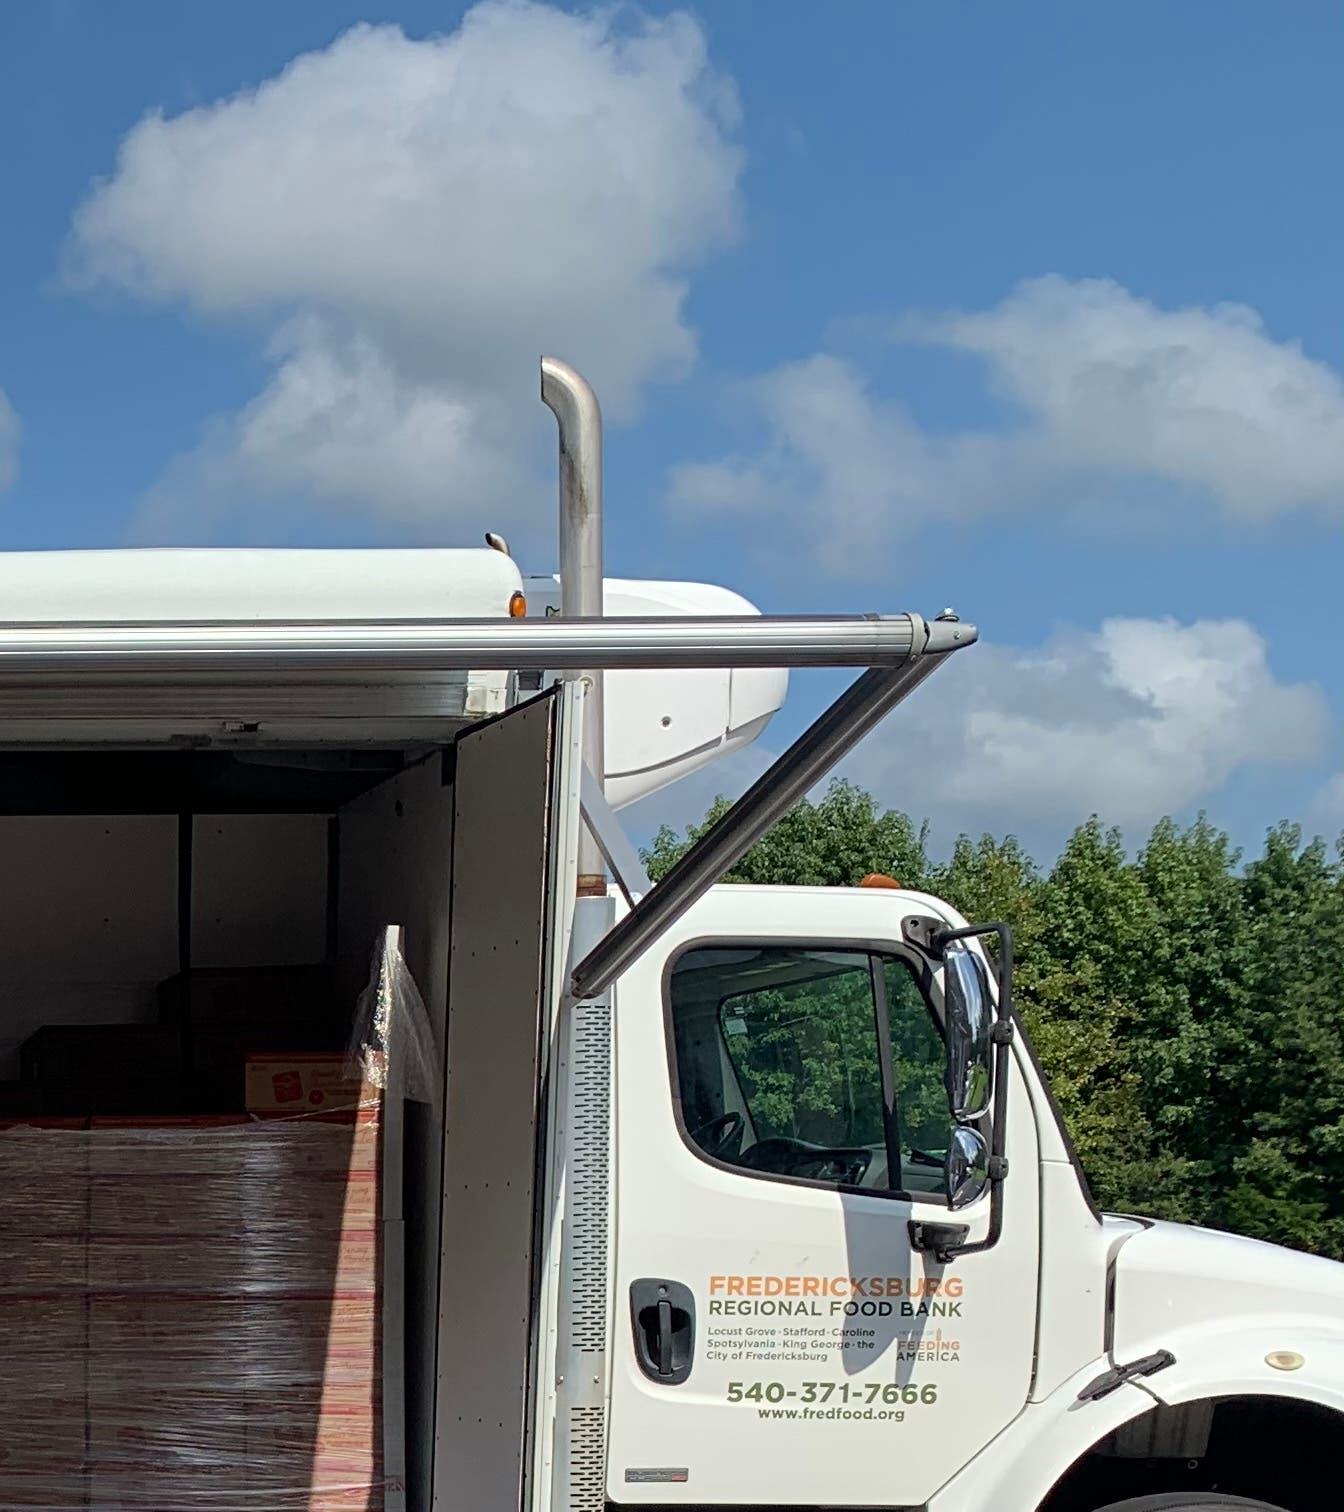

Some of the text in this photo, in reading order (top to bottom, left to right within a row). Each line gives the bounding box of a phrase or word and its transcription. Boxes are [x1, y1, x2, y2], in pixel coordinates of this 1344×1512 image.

[709, 1275, 964, 1298] FREDERICKSBURG
[709, 1300, 963, 1317] REGIONAL FOOD BANK
[708, 1327, 876, 1337] Locust Grove Stafford Caroline
[707, 1339, 875, 1350] Spotsylvania King George the
[897, 1341, 961, 1351] FEEDING
[706, 1351, 828, 1362] City of Fredericksburg
[896, 1352, 960, 1361] AMERICA
[726, 1382, 938, 1404] 540-371-7666
[758, 1407, 905, 1422] www.fredfood.org
